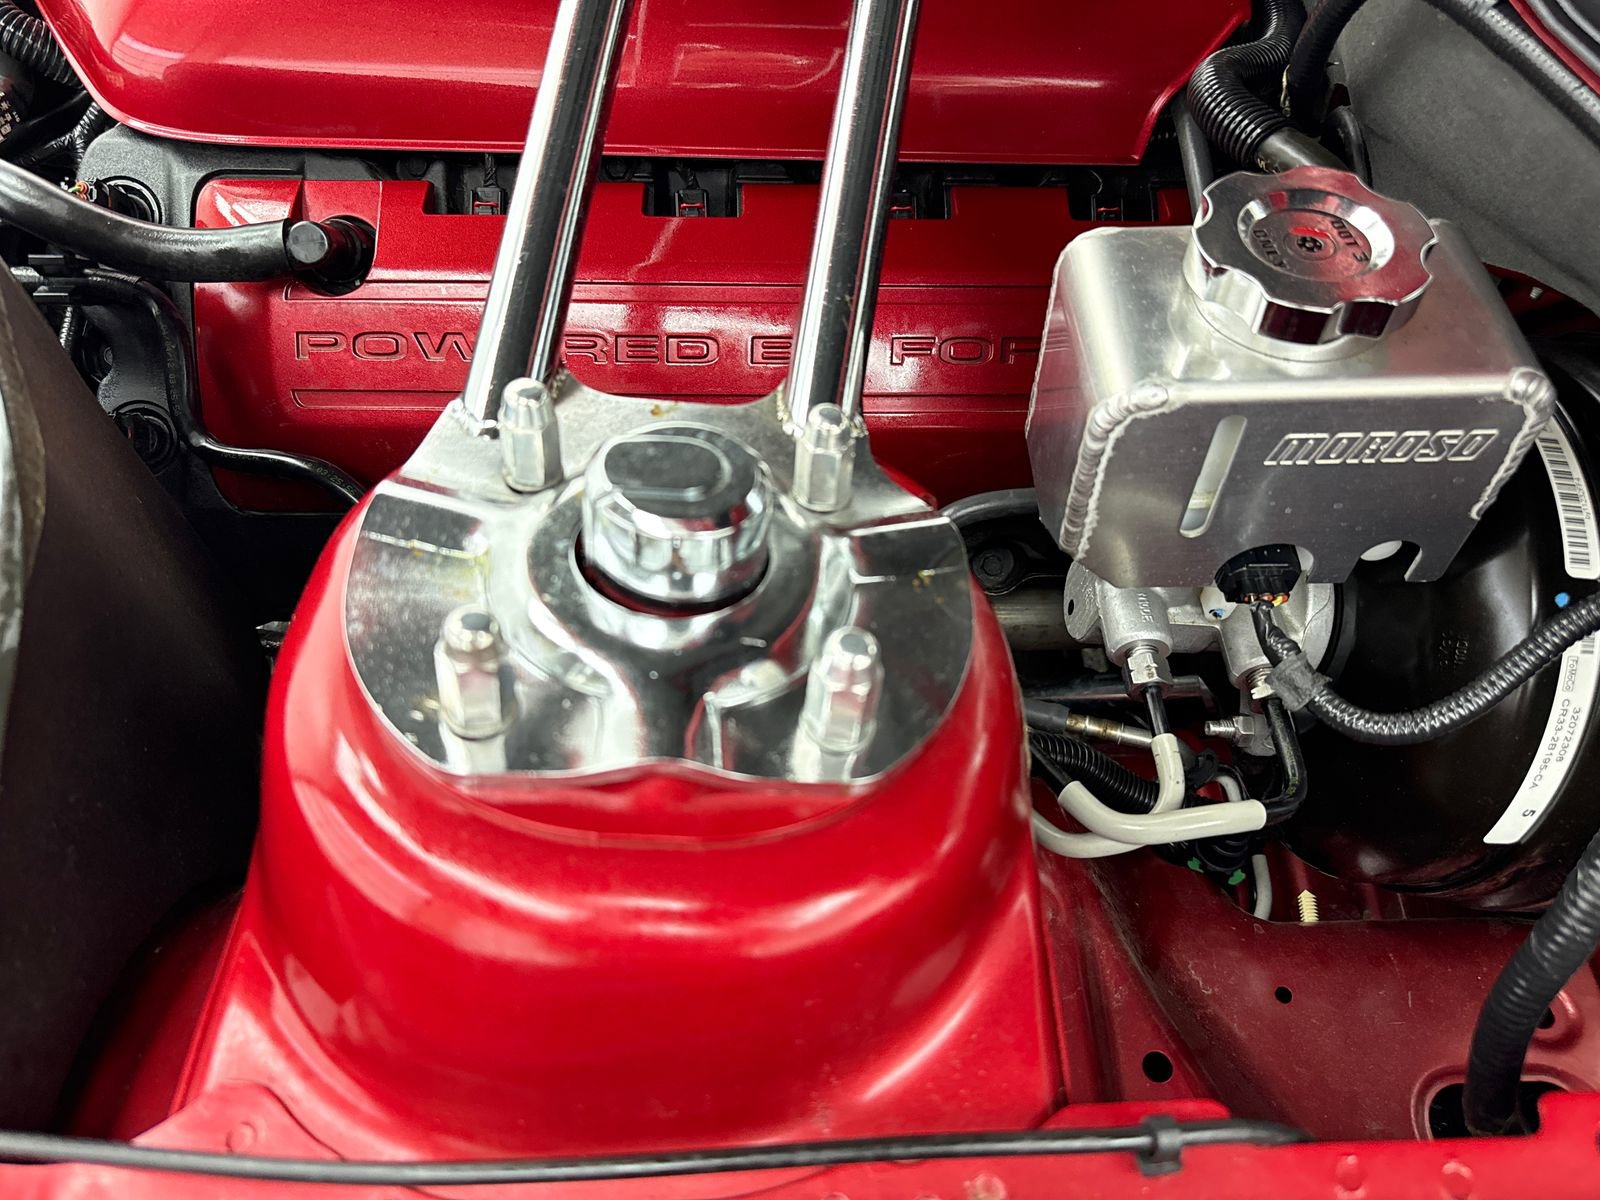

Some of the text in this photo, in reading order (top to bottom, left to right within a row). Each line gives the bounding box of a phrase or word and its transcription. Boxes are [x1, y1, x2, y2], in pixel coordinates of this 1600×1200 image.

[1331, 218, 1370, 263] DOT 3
[295, 331, 1042, 366] POWRED B FOR
[1556, 707, 1581, 763] 32072308
[1522, 808, 1536, 818] 5
